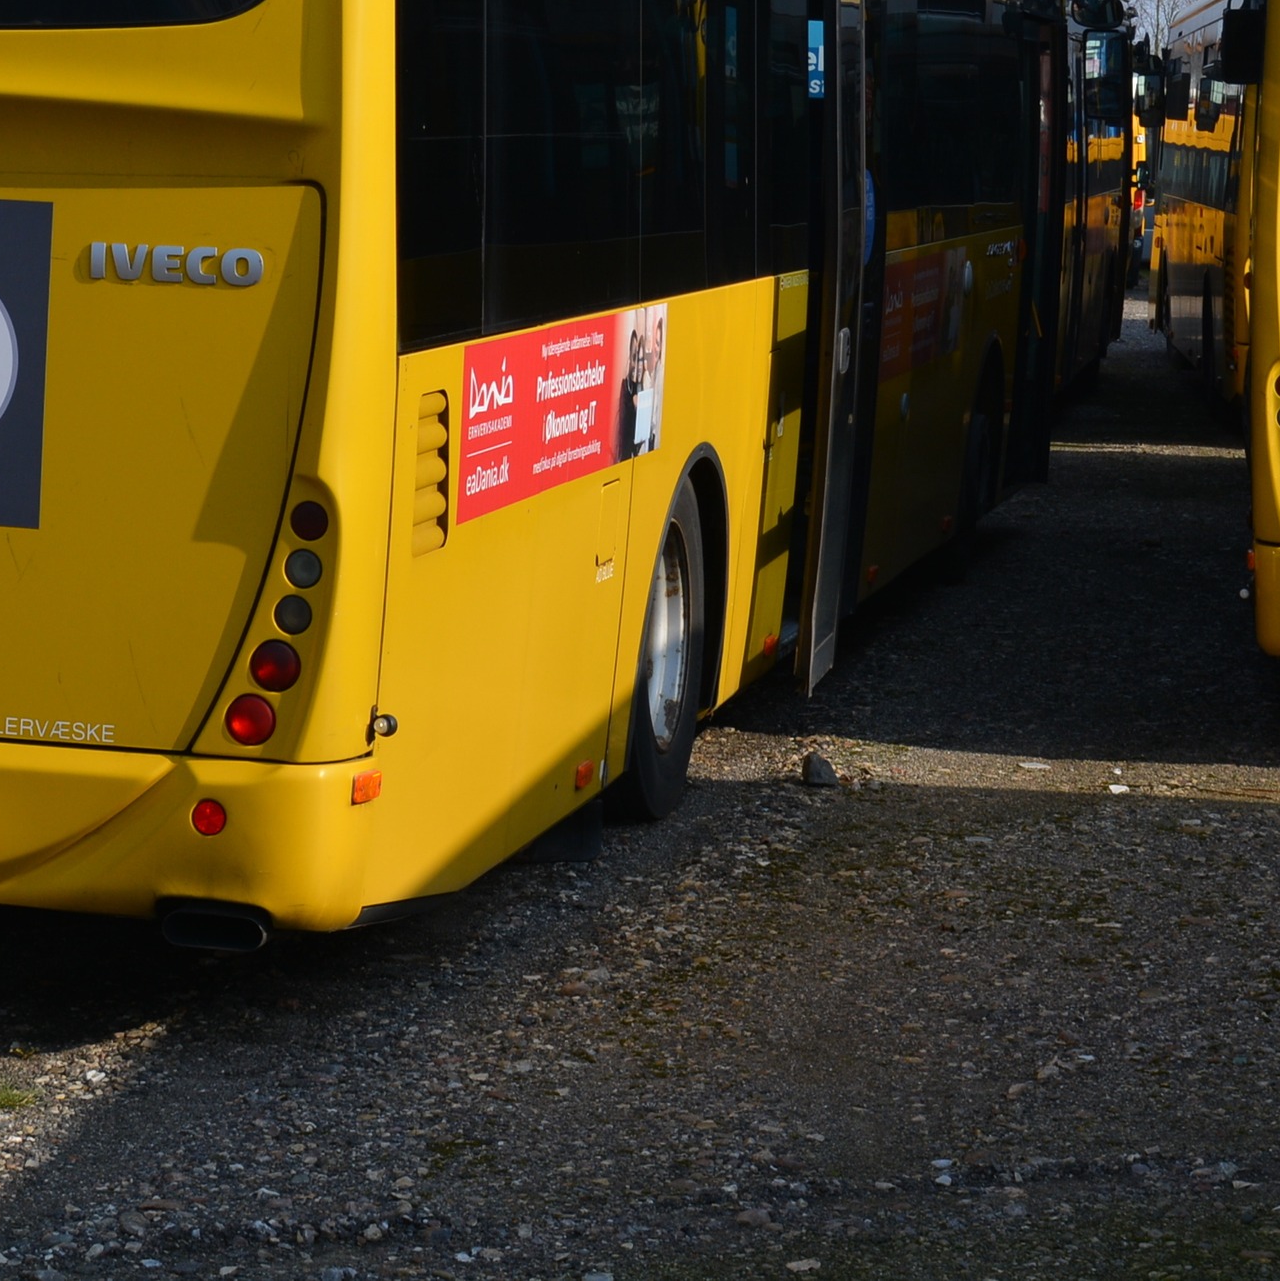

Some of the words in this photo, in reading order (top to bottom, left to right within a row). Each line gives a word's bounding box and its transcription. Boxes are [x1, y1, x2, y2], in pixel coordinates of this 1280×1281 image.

[90, 241, 265, 286] IVECO
[545, 404, 579, 445] Økonomi
[579, 408, 589, 435] og
[588, 400, 597, 427] IT
[465, 455, 510, 496] eaDania.dk
